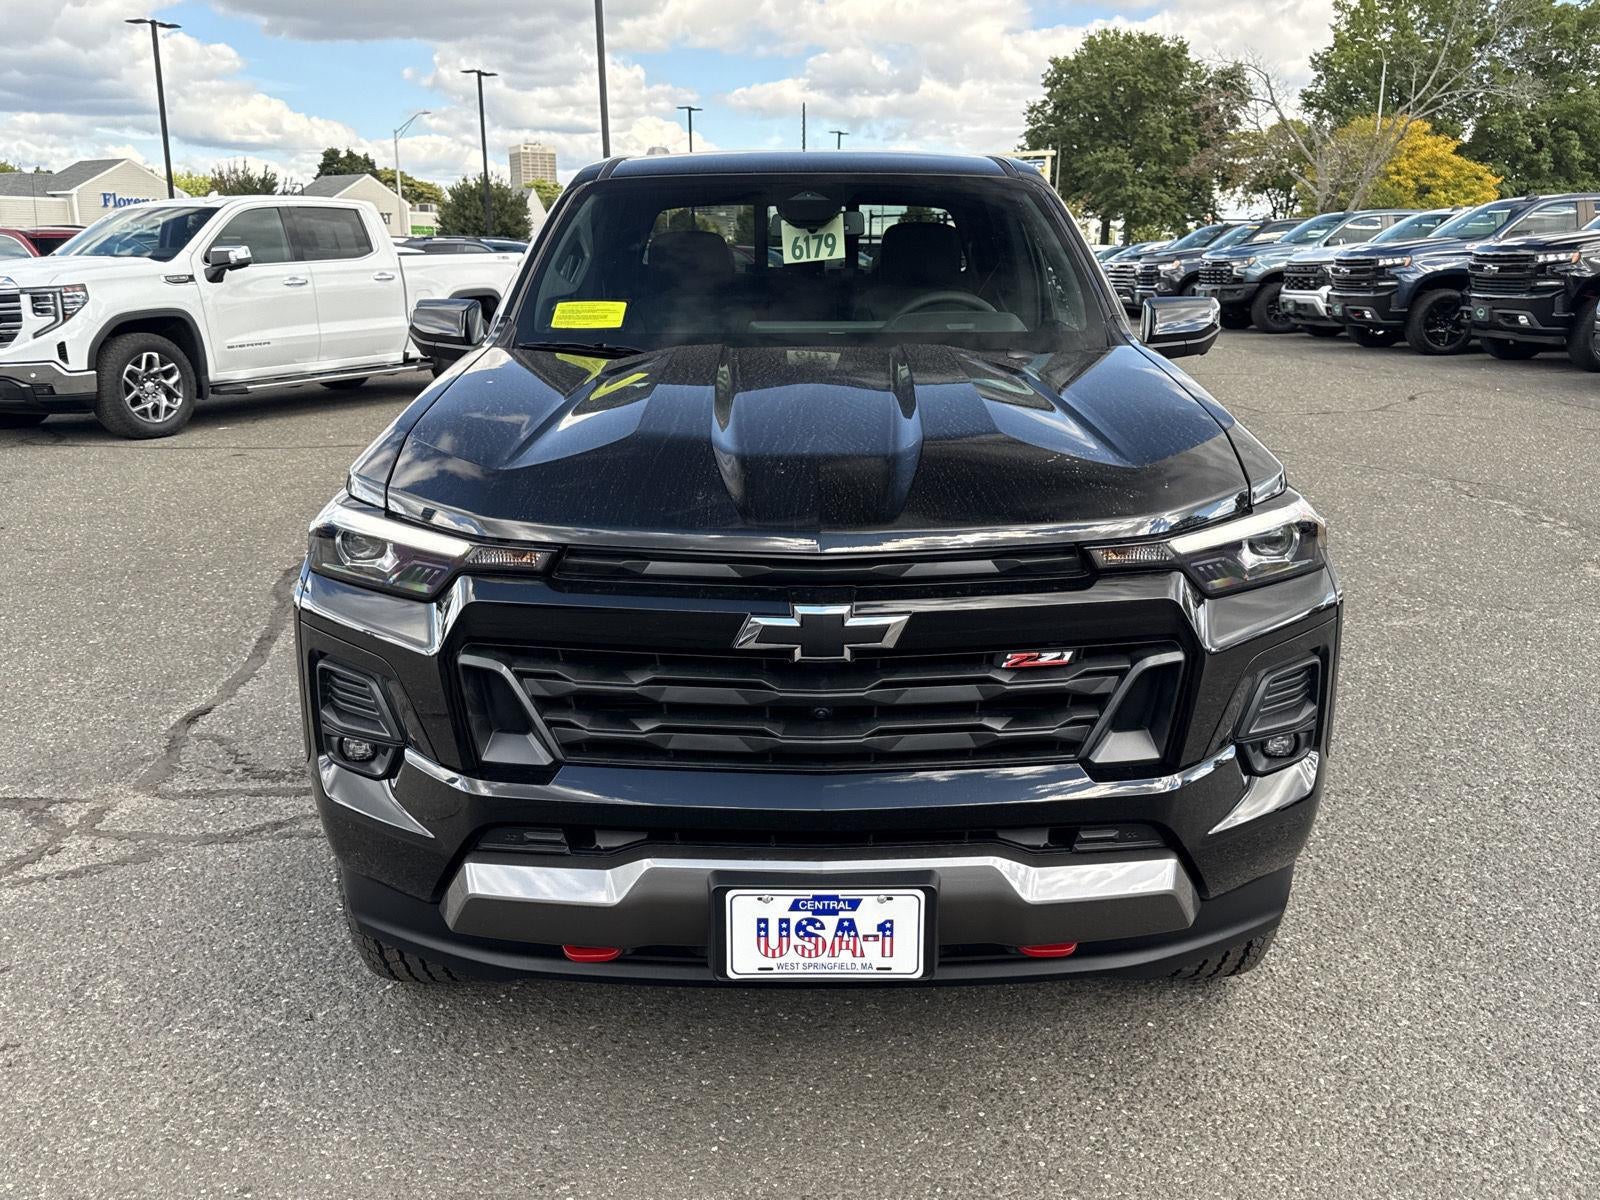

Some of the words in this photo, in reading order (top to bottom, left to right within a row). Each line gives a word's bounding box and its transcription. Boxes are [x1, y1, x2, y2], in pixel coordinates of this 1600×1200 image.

[791, 233, 837, 260] 6179
[1001, 651, 1074, 668] Z71
[798, 902, 852, 911] CENTRAL
[756, 917, 894, 958] USA-1
[776, 962, 799, 971] WEST
[802, 962, 859, 972] SPRINGFIELD,
[861, 962, 874, 971] MA
